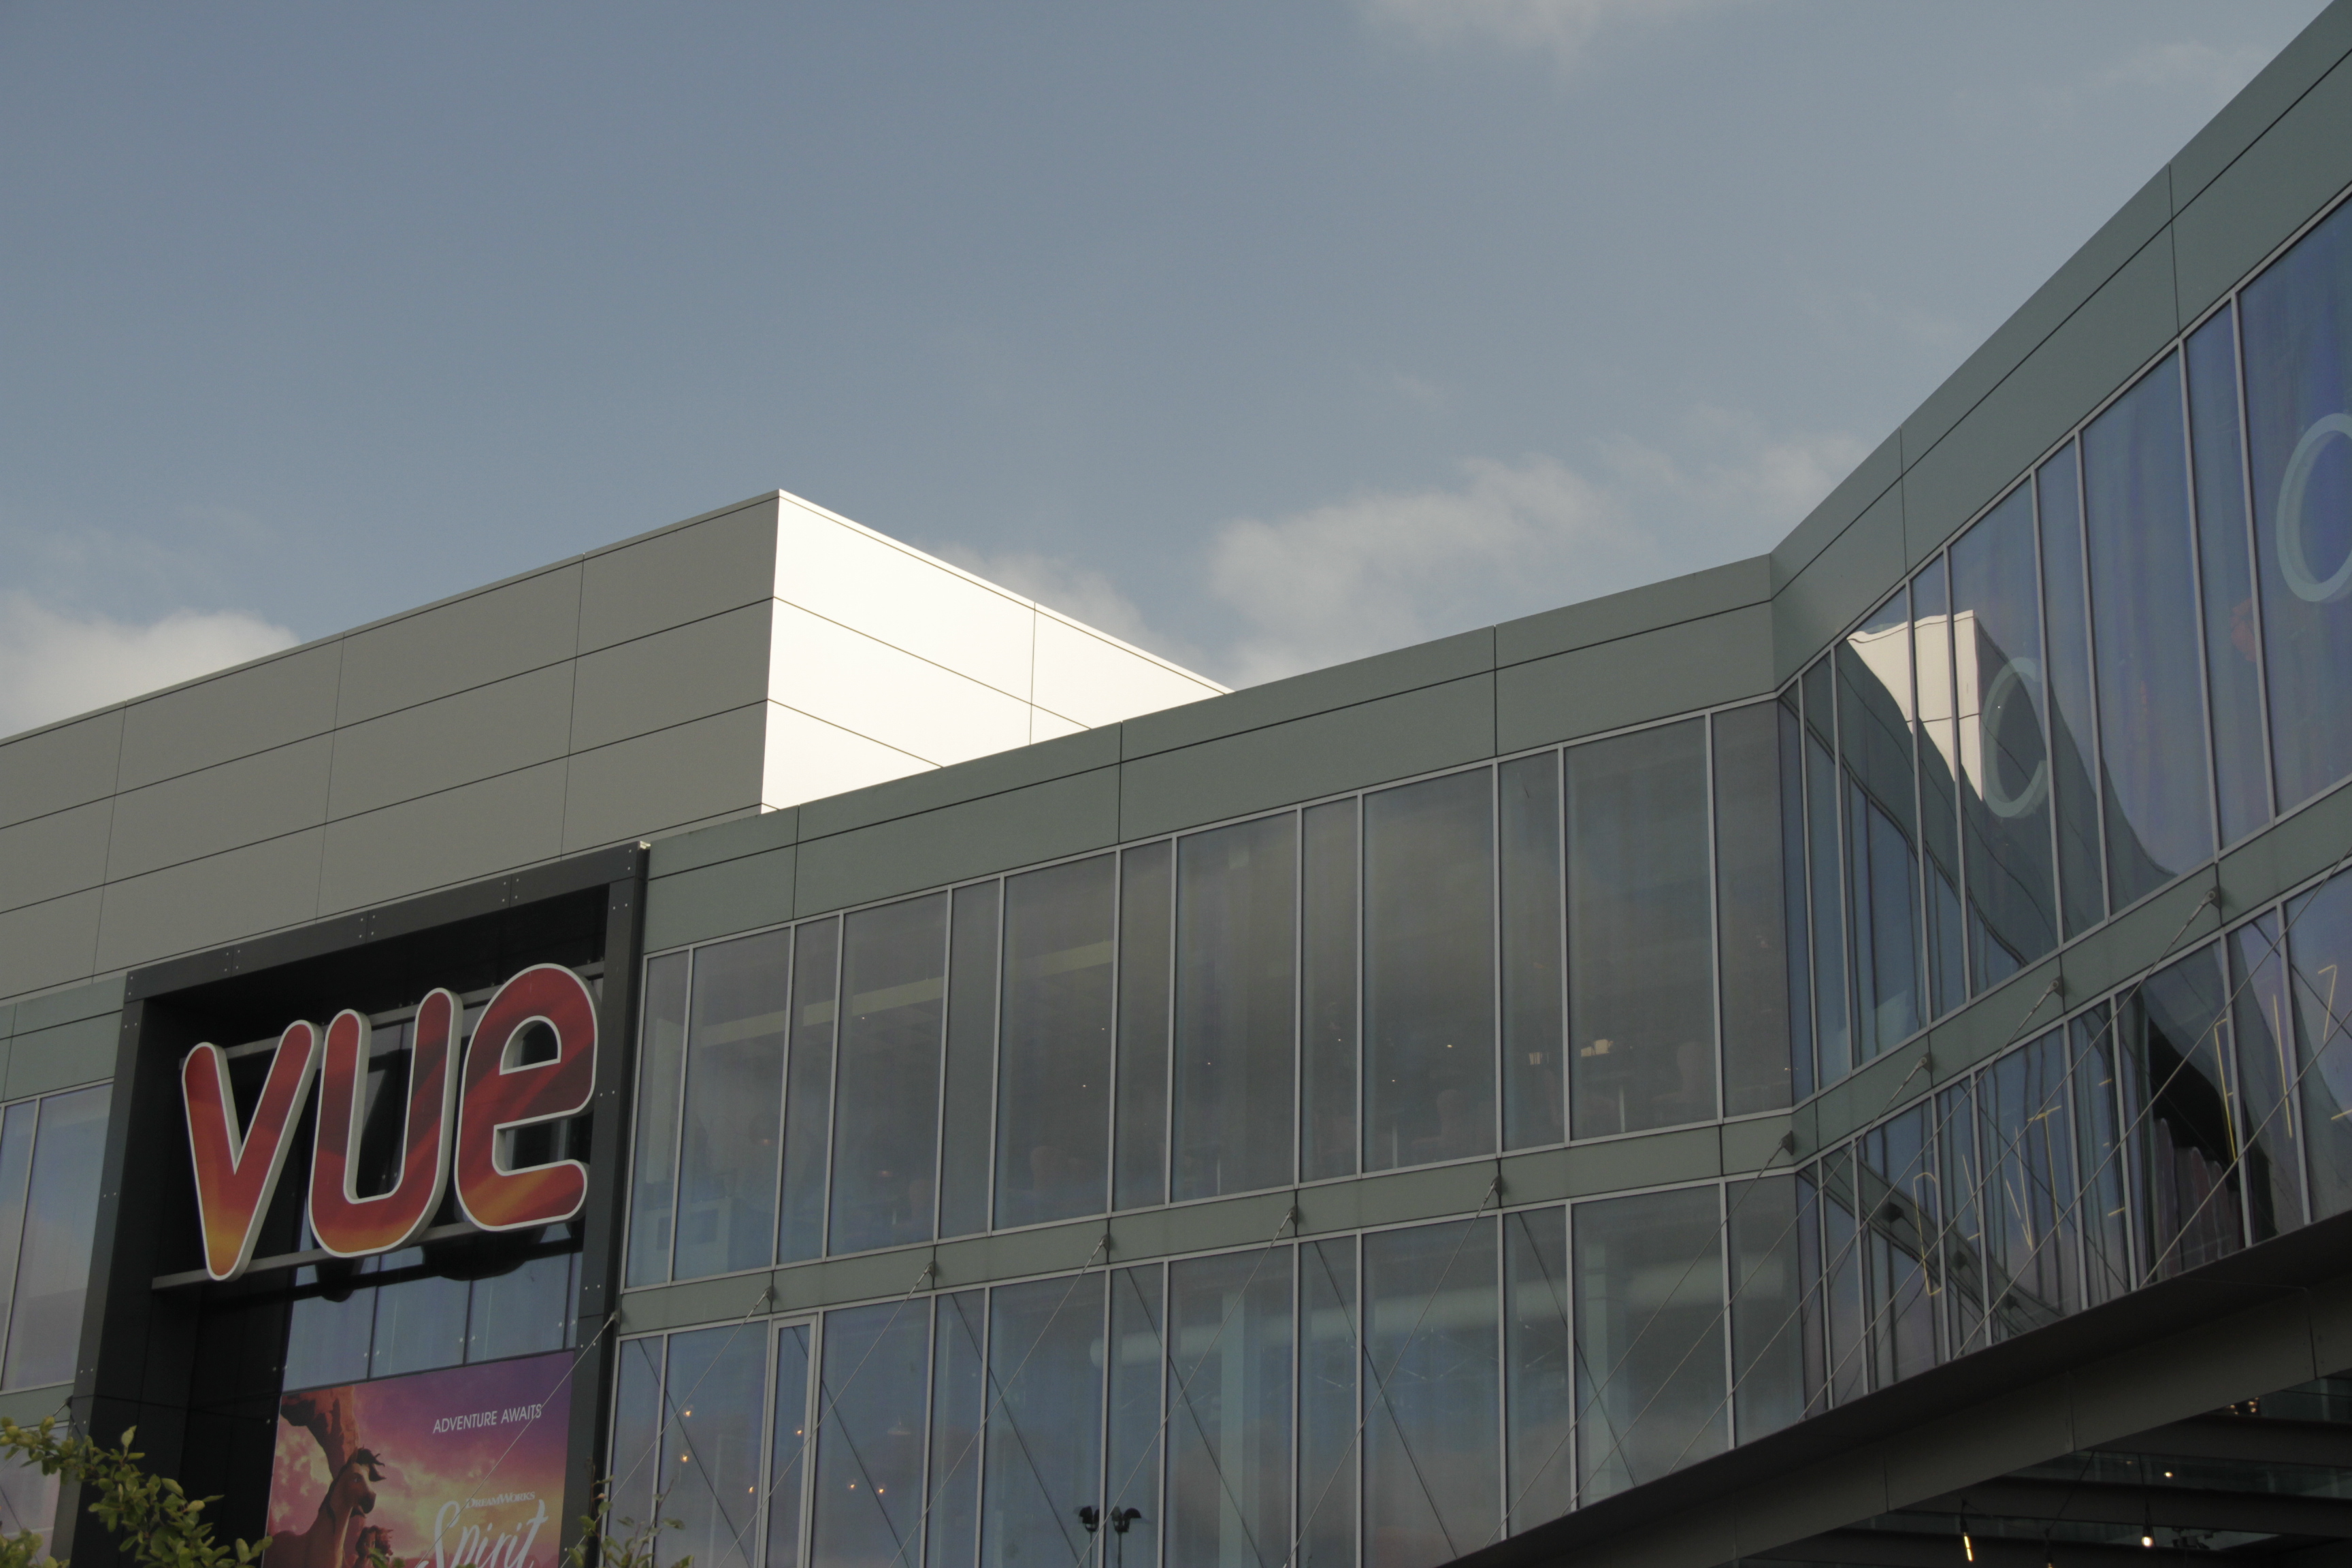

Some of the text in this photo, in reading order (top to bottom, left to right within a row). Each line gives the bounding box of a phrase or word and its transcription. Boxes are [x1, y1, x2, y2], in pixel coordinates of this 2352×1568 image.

[433, 1403, 542, 1433] ADVENTURE AWAITS
[415, 1499, 549, 1568] Spirit
